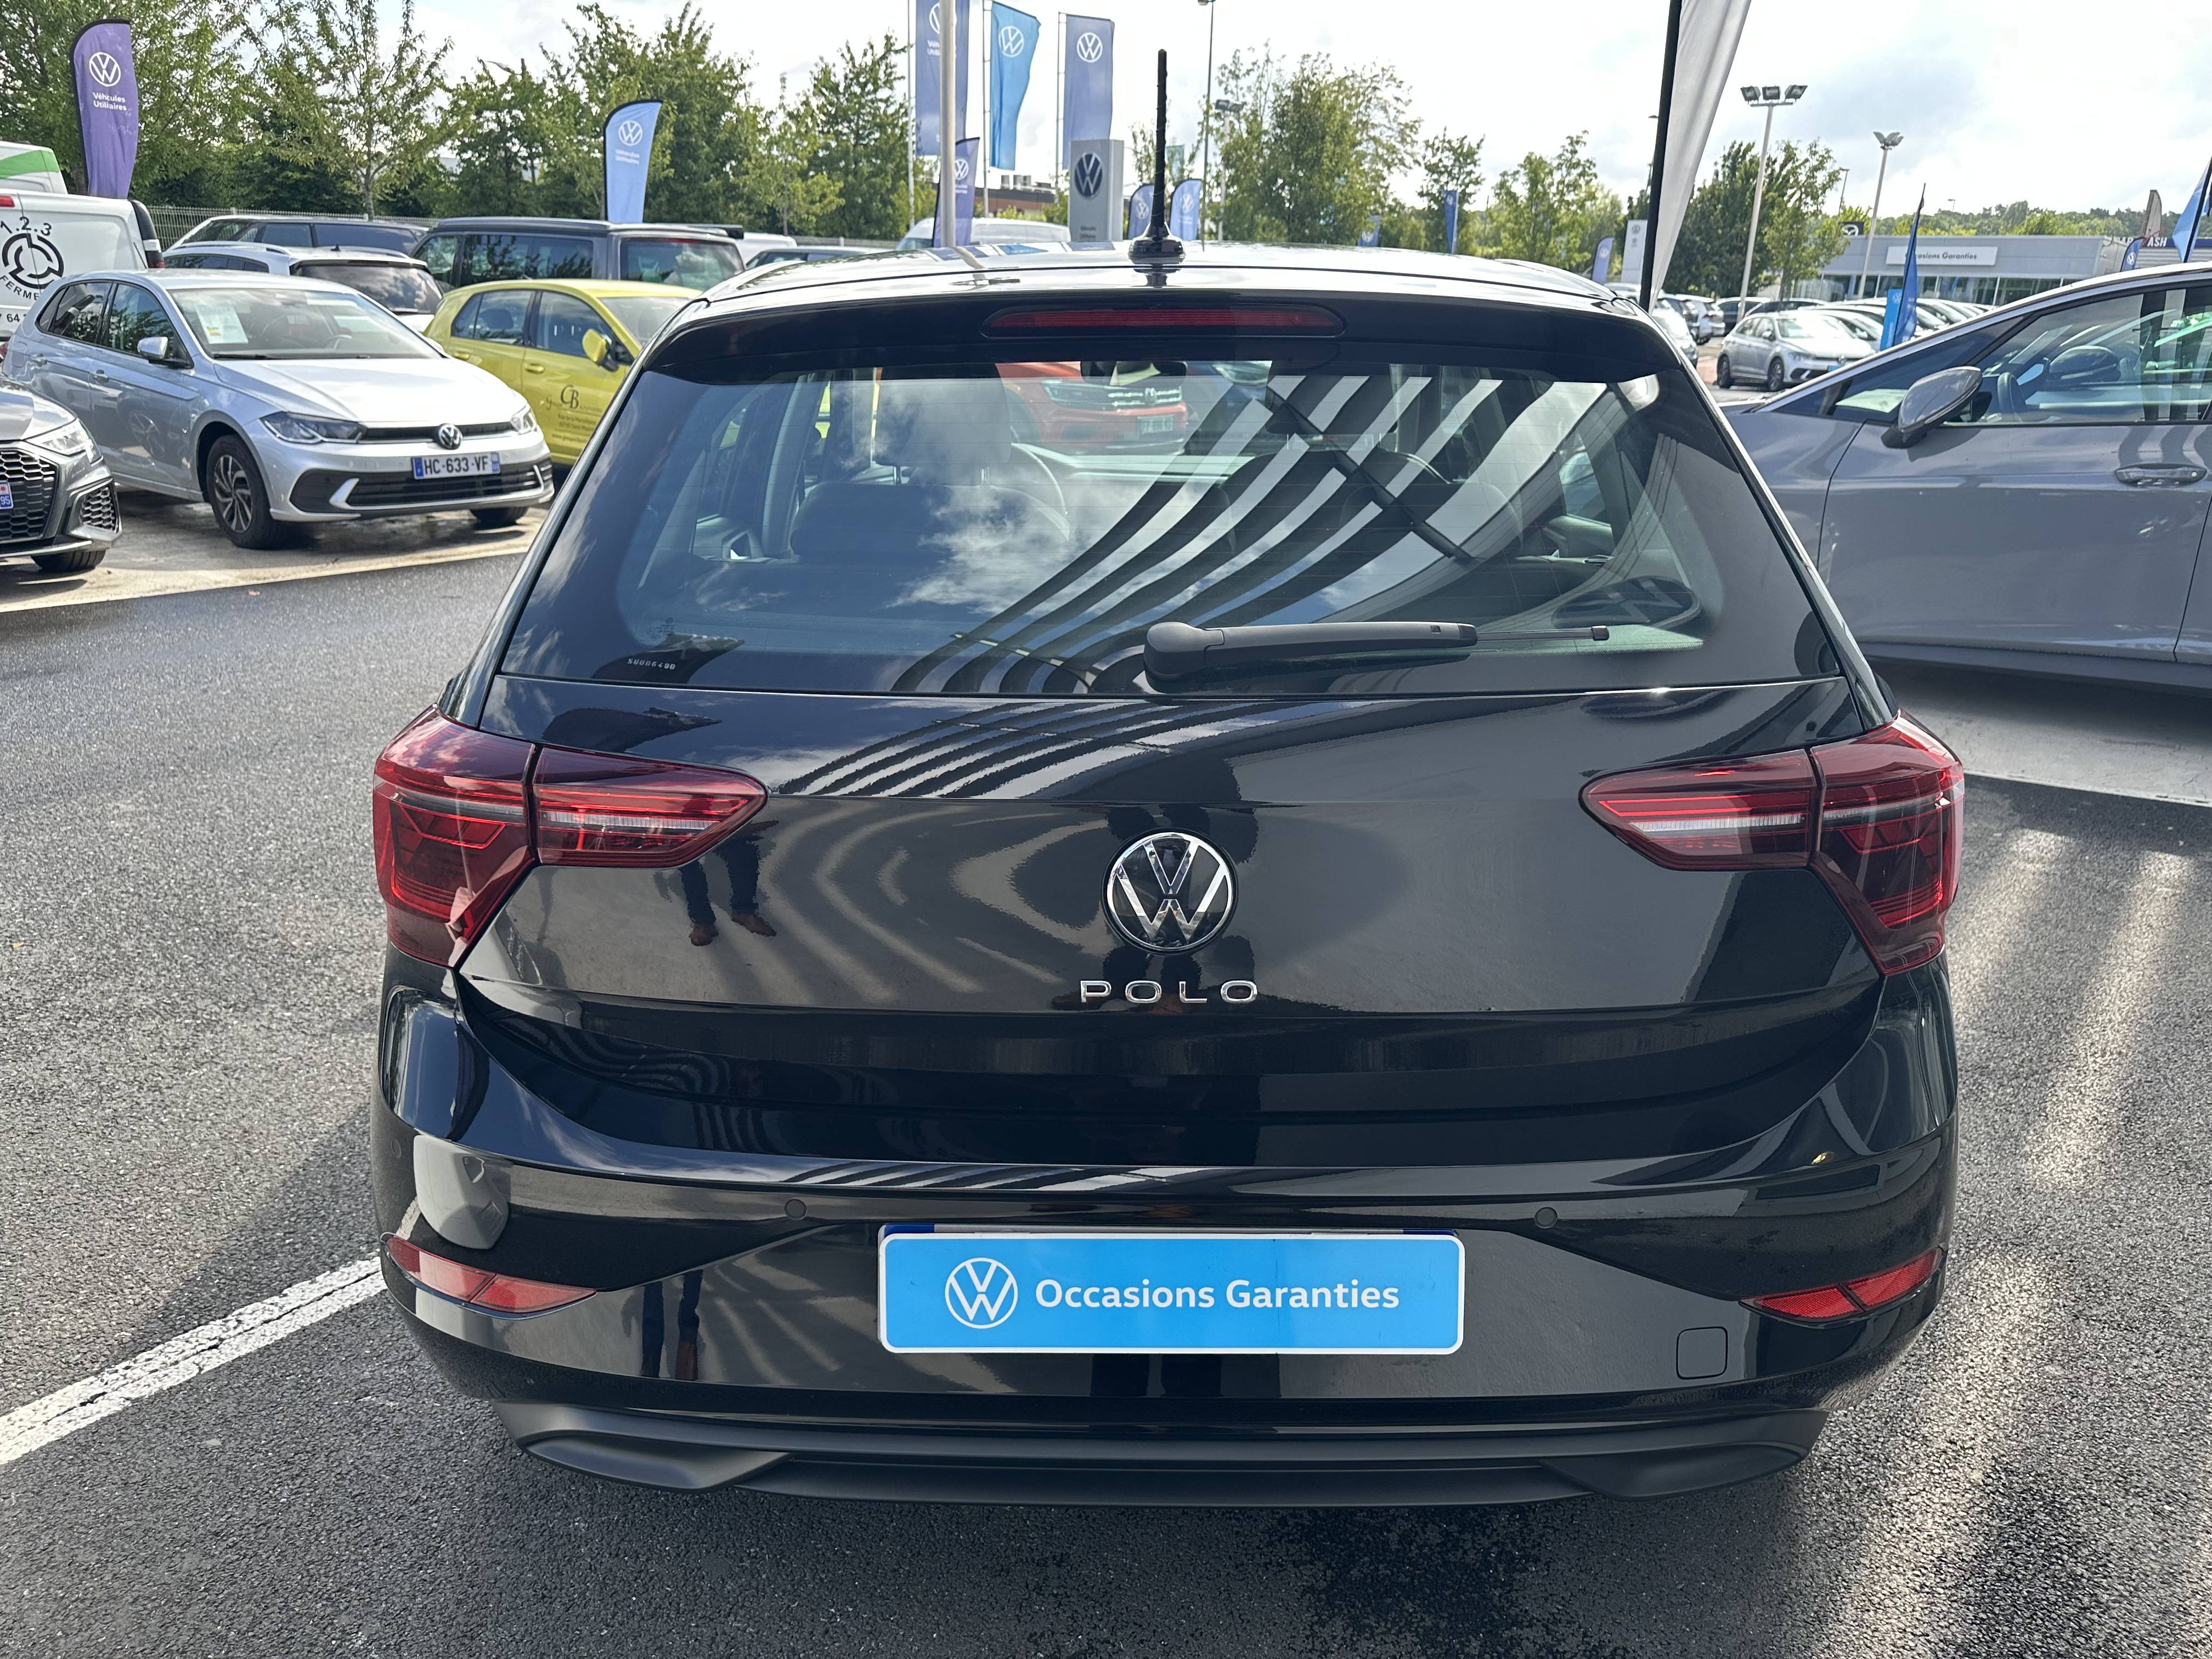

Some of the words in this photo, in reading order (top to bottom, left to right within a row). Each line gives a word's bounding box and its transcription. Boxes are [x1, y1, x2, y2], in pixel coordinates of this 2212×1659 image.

[2145, 236, 2168, 247] ASH
[7, 313, 20, 323] 64
[561, 385, 579, 409] CB
[1080, 980, 1258, 1004] POLO
[1035, 1278, 1214, 1308] Occasions
[1226, 1279, 1400, 1308] Garanties
